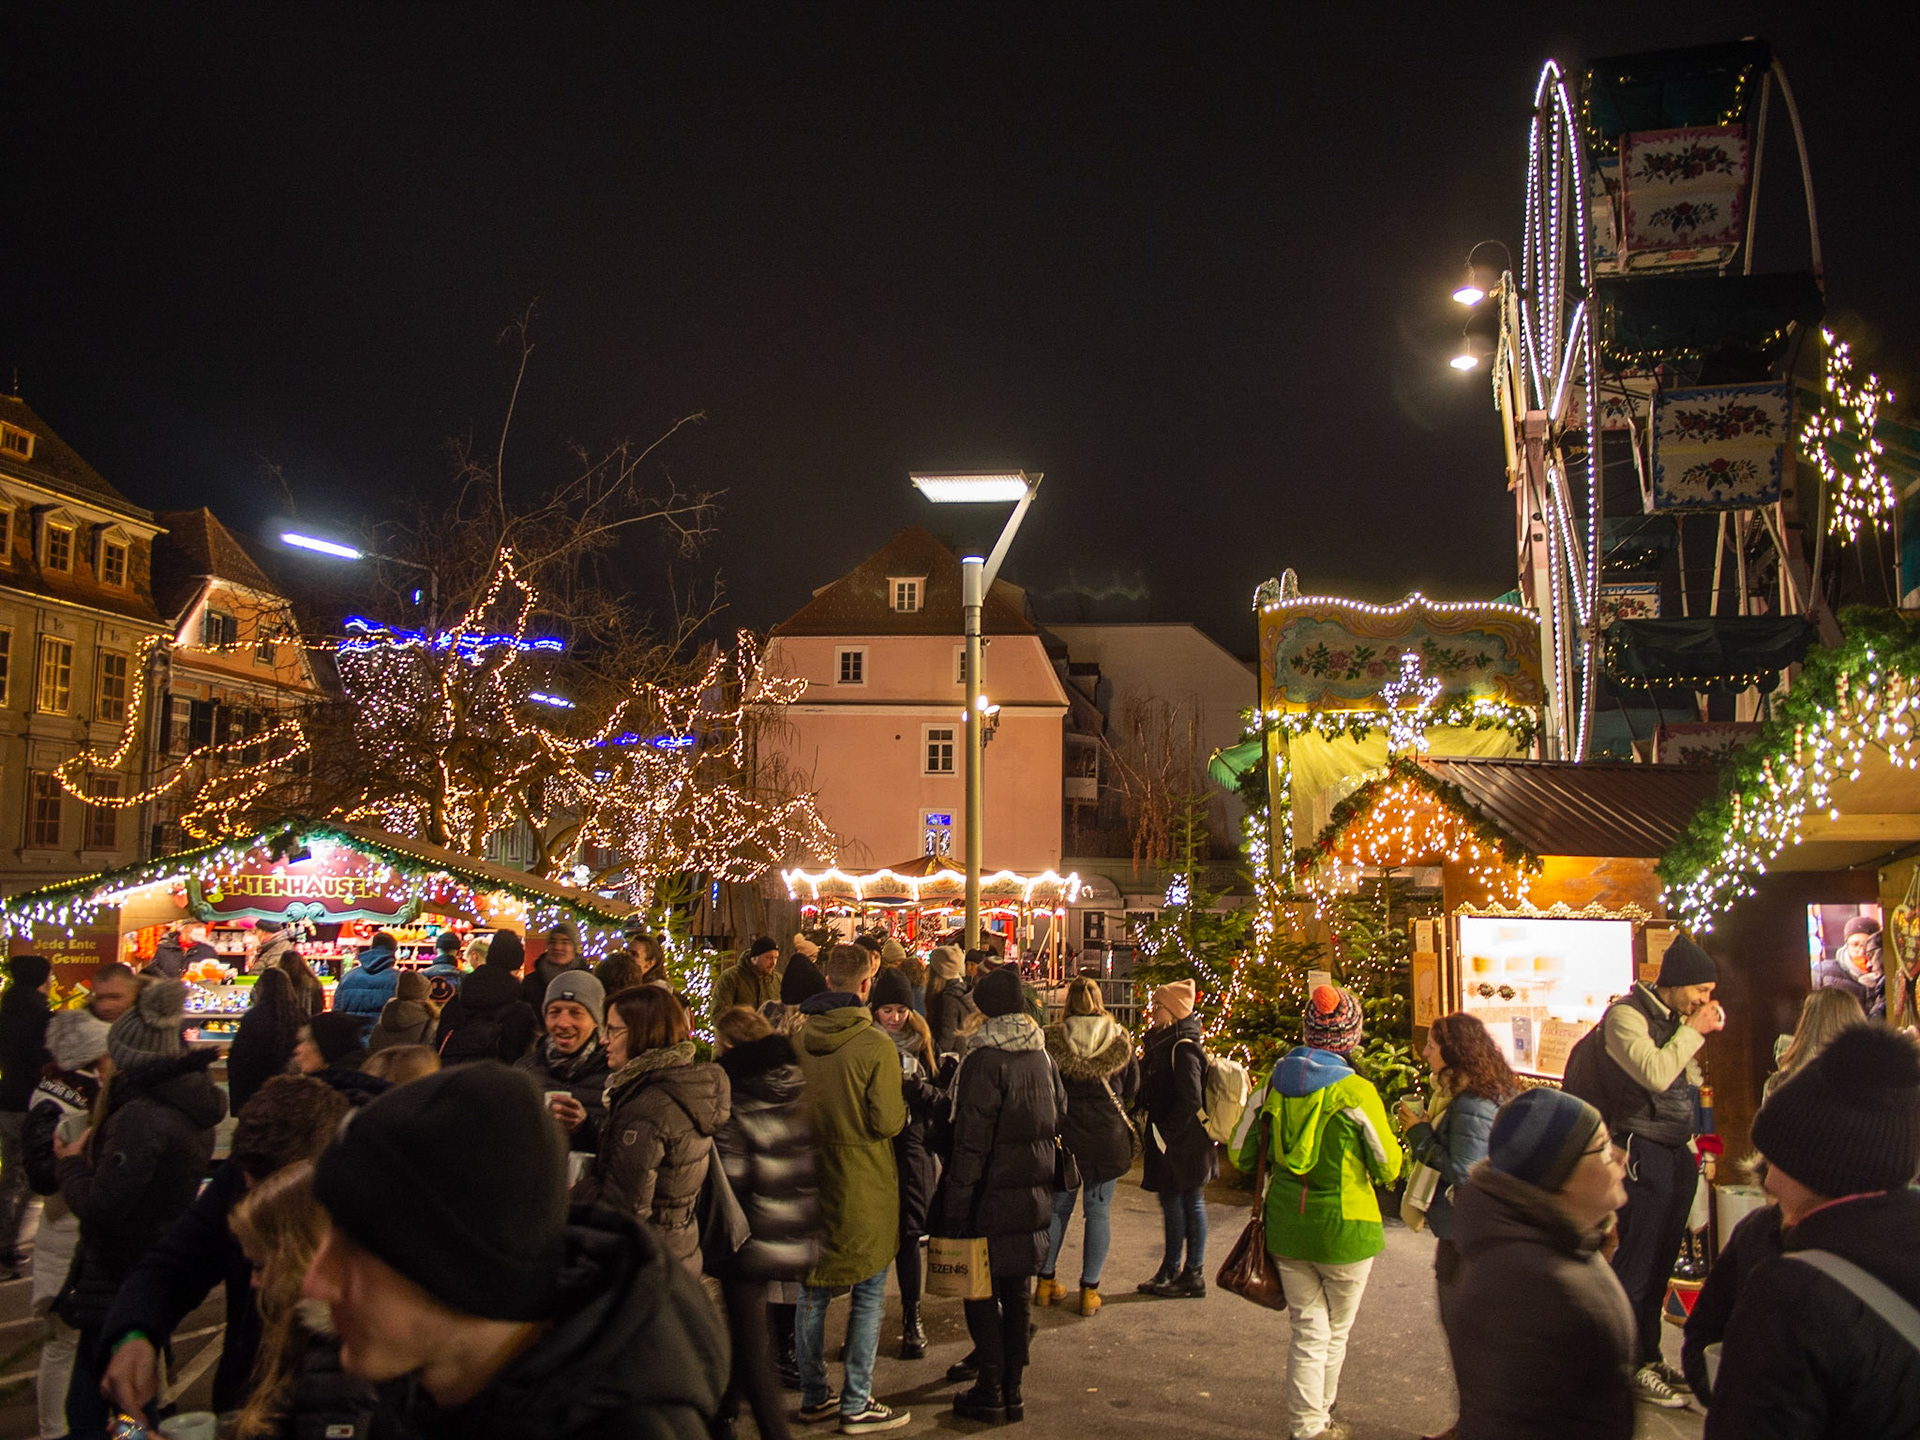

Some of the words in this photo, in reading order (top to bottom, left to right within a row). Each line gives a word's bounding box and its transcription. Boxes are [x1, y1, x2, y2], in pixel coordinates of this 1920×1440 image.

[219, 874, 381, 899] ENTENHAUSEN
[33, 939, 65, 950] Jede
[68, 939, 97, 950] Ente
[52, 952, 100, 965] Gewinn
